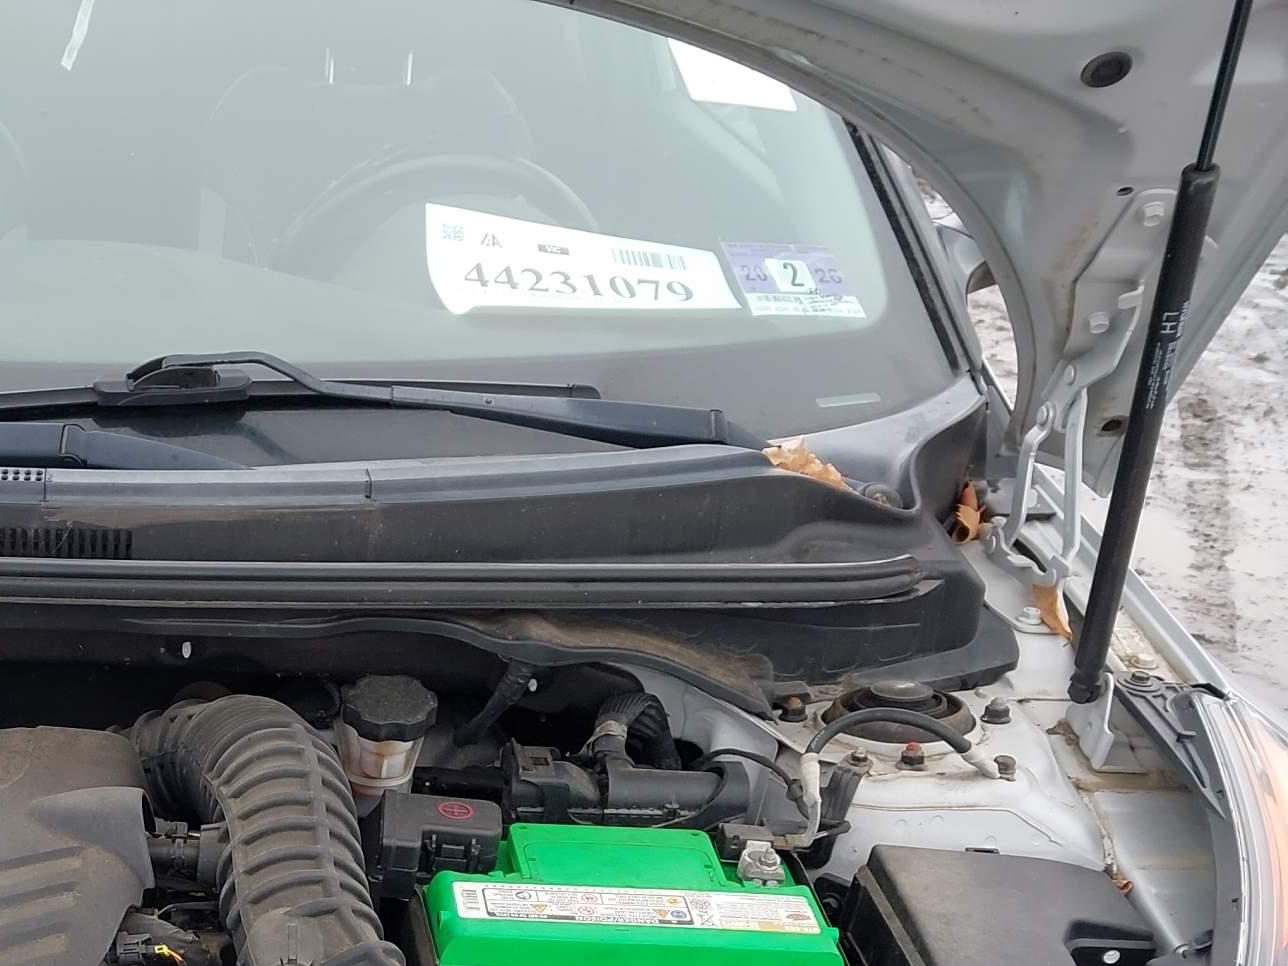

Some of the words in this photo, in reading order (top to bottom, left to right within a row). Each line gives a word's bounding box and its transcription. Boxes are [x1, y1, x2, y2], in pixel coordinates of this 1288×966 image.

[464, 262, 693, 302] 44231079
[782, 261, 805, 287] 2
[1160, 311, 1180, 334] LH
